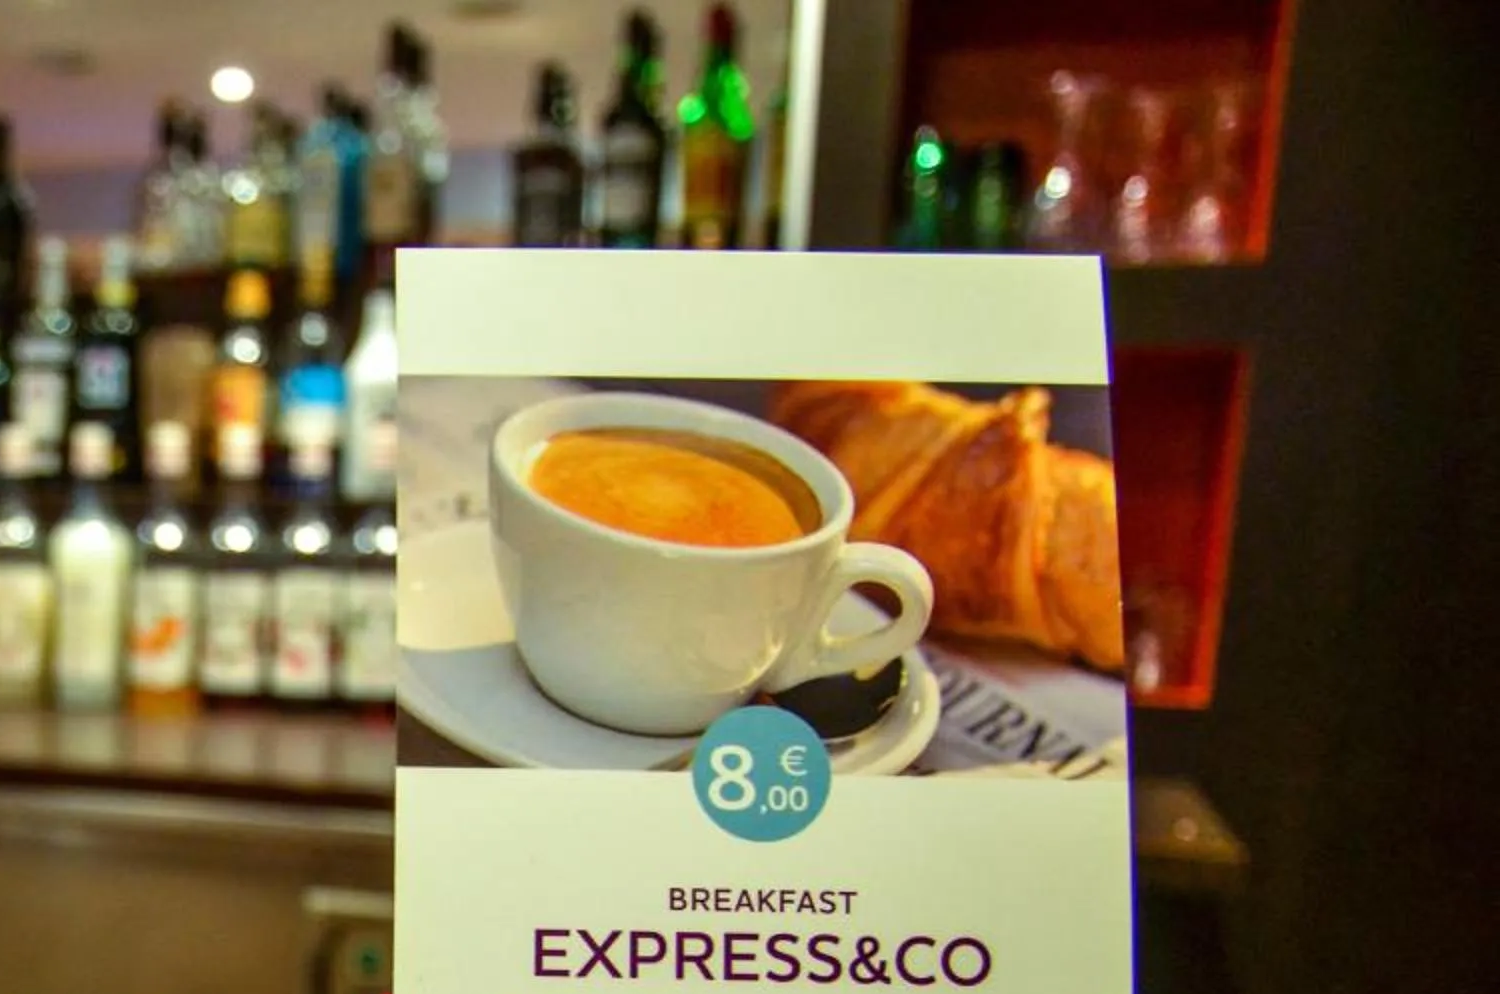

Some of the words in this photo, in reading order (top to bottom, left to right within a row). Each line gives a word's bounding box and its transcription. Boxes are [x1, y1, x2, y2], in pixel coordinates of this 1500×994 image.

[780, 745, 808, 777] €
[668, 886, 858, 916] BREAKFAST
[533, 928, 993, 987] EXPRESS&CO
